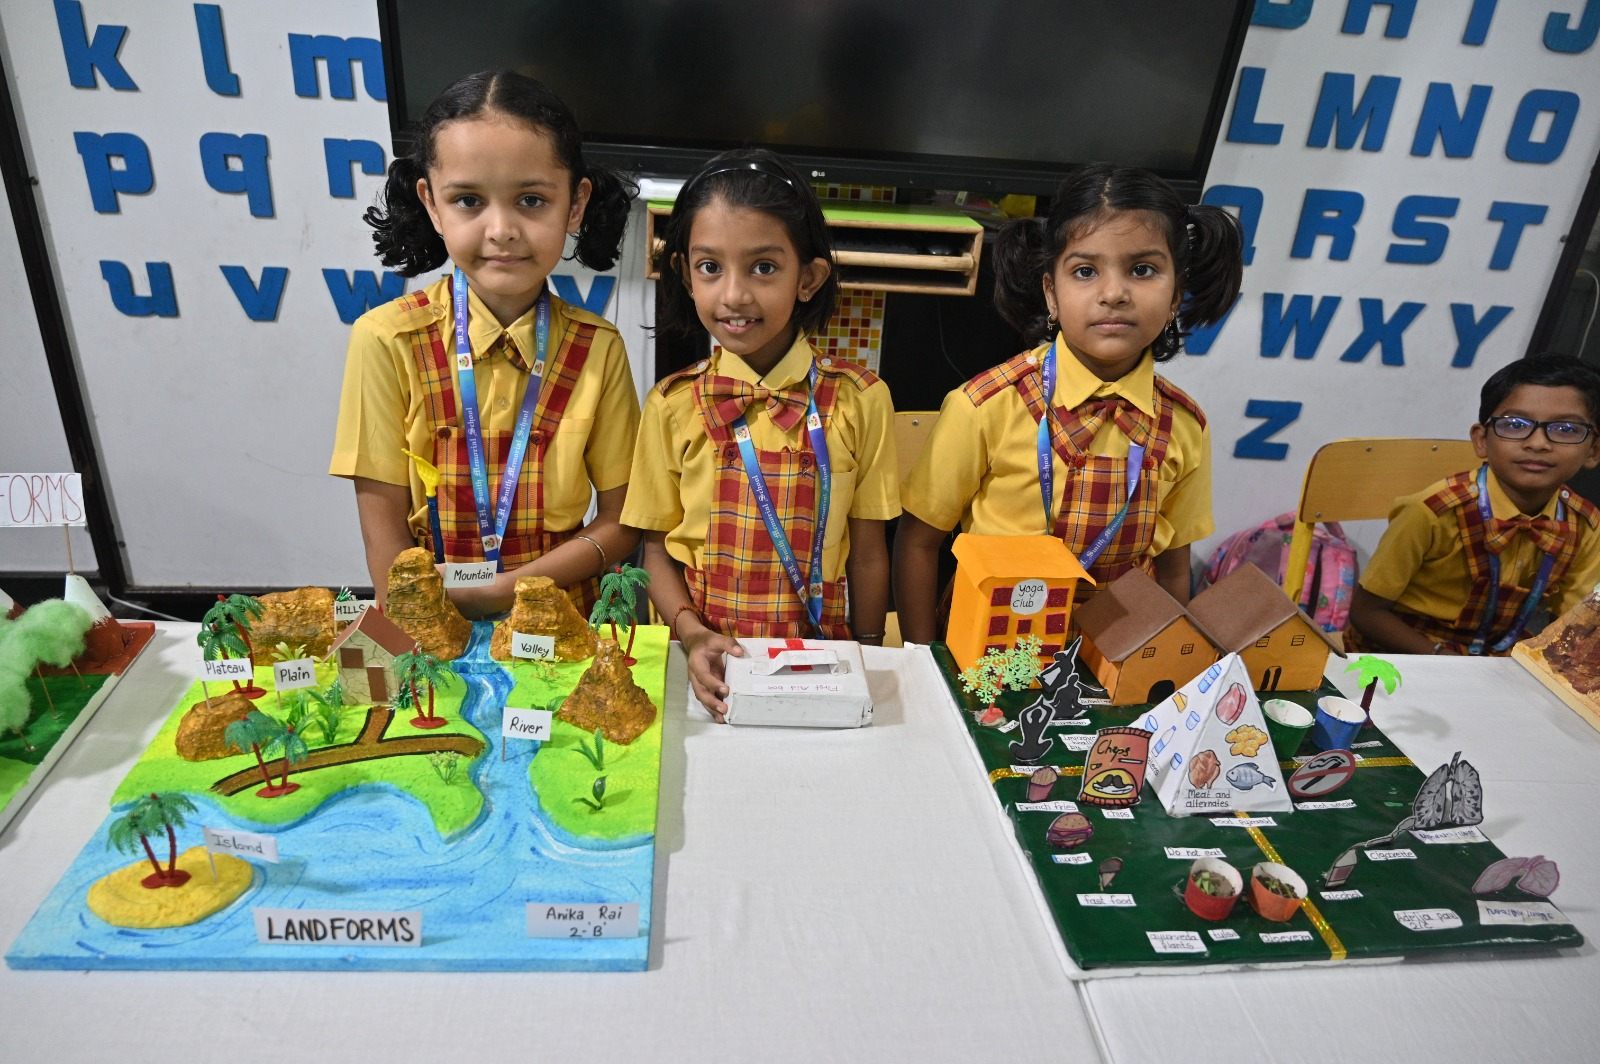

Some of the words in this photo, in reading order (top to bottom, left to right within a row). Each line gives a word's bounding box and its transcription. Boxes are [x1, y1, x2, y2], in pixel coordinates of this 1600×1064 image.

[53, 0, 137, 91] k
[194, 3, 240, 96] l
[288, 33, 388, 100] m
[1226, 66, 1284, 145] L
[1306, 72, 1401, 152] M
[1410, 82, 1493, 158] N
[1505, 89, 1580, 164] O
[74, 132, 154, 213] p
[200, 132, 275, 218] q
[323, 137, 386, 198] r
[1290, 189, 1365, 261] R
[1386, 195, 1461, 265] S
[1487, 201, 1549, 271] T
[100, 261, 179, 317] u
[219, 265, 289, 321] v
[455, 294, 464, 320] Smith
[1260, 293, 1343, 360] W
[1339, 298, 1427, 366] X
[1450, 303, 1514, 368] Y
[464, 406, 476, 436] School
[1233, 399, 1303, 460] Z
[468, 437, 482, 477] Memorial
[506, 439, 522, 477] Memorial
[1041, 453, 1051, 479] School
[475, 479, 485, 504] Smith
[499, 478, 514, 505] Smith
[749, 474, 768, 503] School
[761, 503, 781, 539] Memorial
[453, 567, 494, 581] Mountain
[336, 603, 366, 615] HILLS
[521, 643, 550, 657] Valley
[205, 661, 247, 675] Plateau
[280, 666, 311, 682] Plain
[509, 716, 543, 734] River
[1185, 798, 1230, 808] alternates
[1187, 789, 1211, 799] Meat
[1215, 789, 1231, 799] and
[211, 833, 264, 855] Island
[546, 906, 584, 920] Anika
[599, 905, 623, 920] Rai
[267, 917, 415, 943] LANDFORMS
